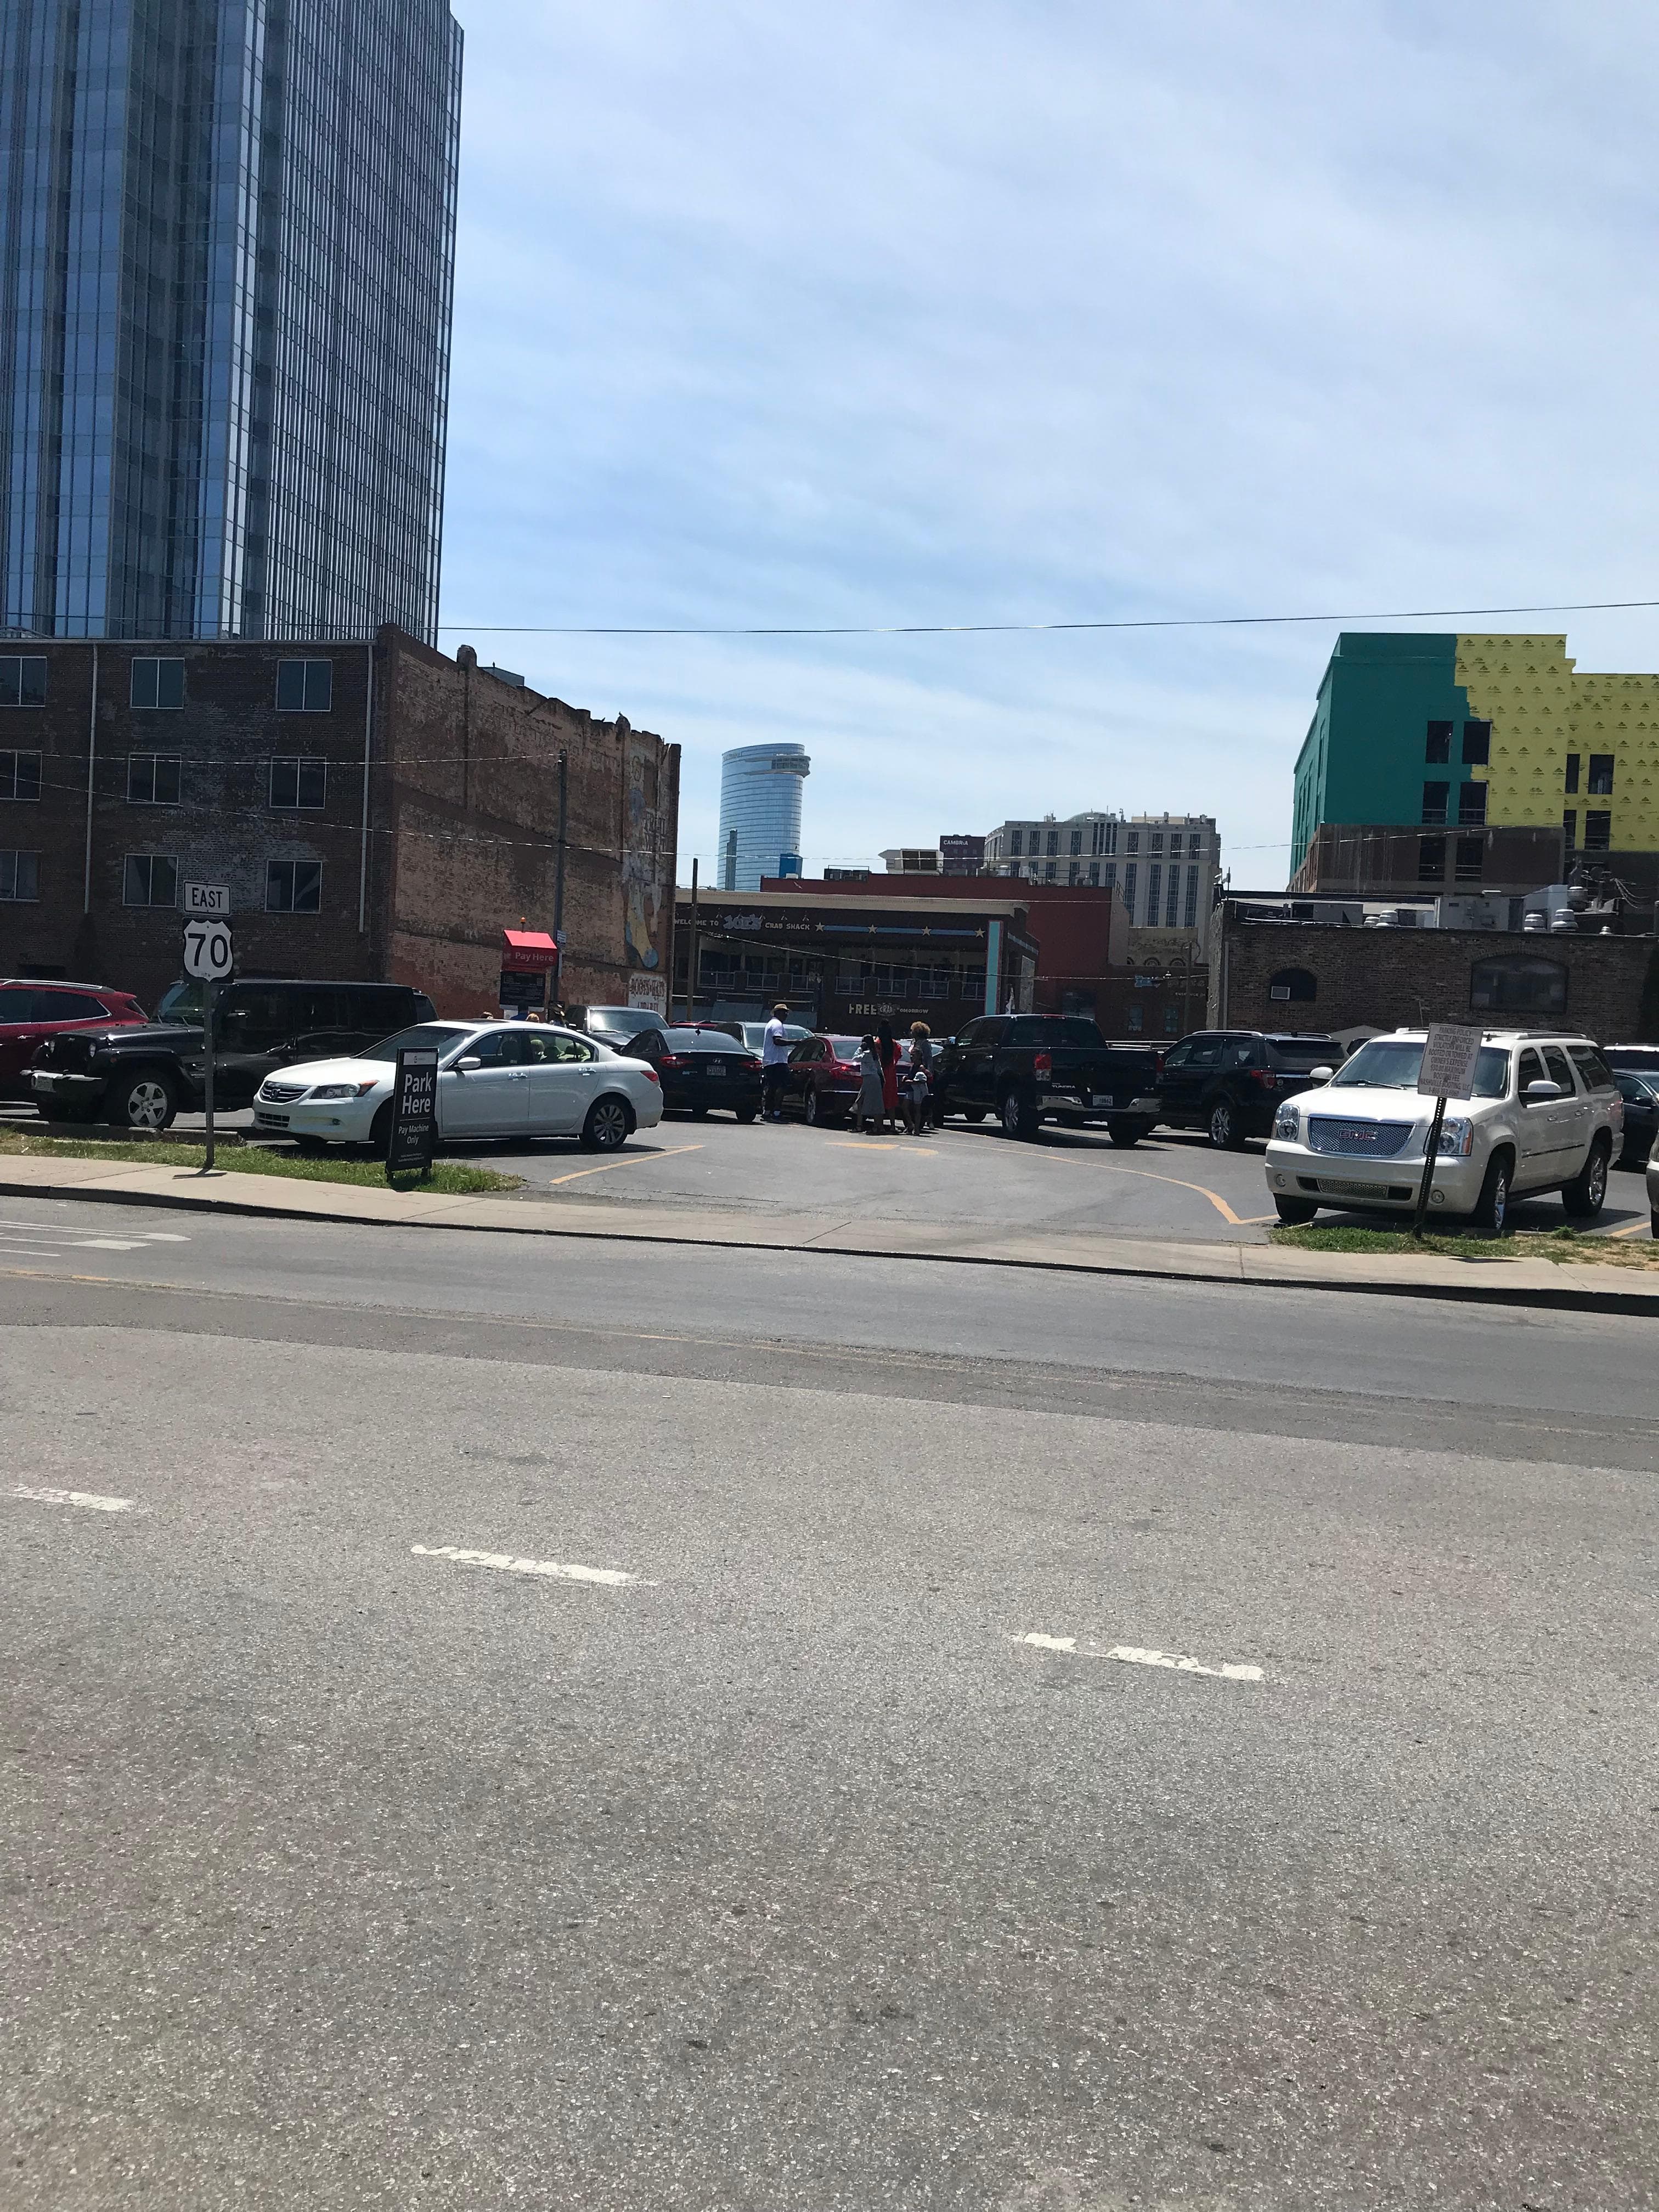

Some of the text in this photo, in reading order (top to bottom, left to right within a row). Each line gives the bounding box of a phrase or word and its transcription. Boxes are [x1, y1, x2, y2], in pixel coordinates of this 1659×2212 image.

[192, 887, 222, 909] EAST
[188, 933, 228, 968] 70
[515, 952, 531, 962] Pay
[533, 953, 554, 962] Here
[849, 1003, 877, 1015] FREE
[404, 1072, 432, 1093] Park
[402, 1095, 431, 1115] Here
[398, 1124, 429, 1136] Pay Machine
[1339, 1130, 1376, 1141] GMC
[407, 1136, 419, 1146] Only
